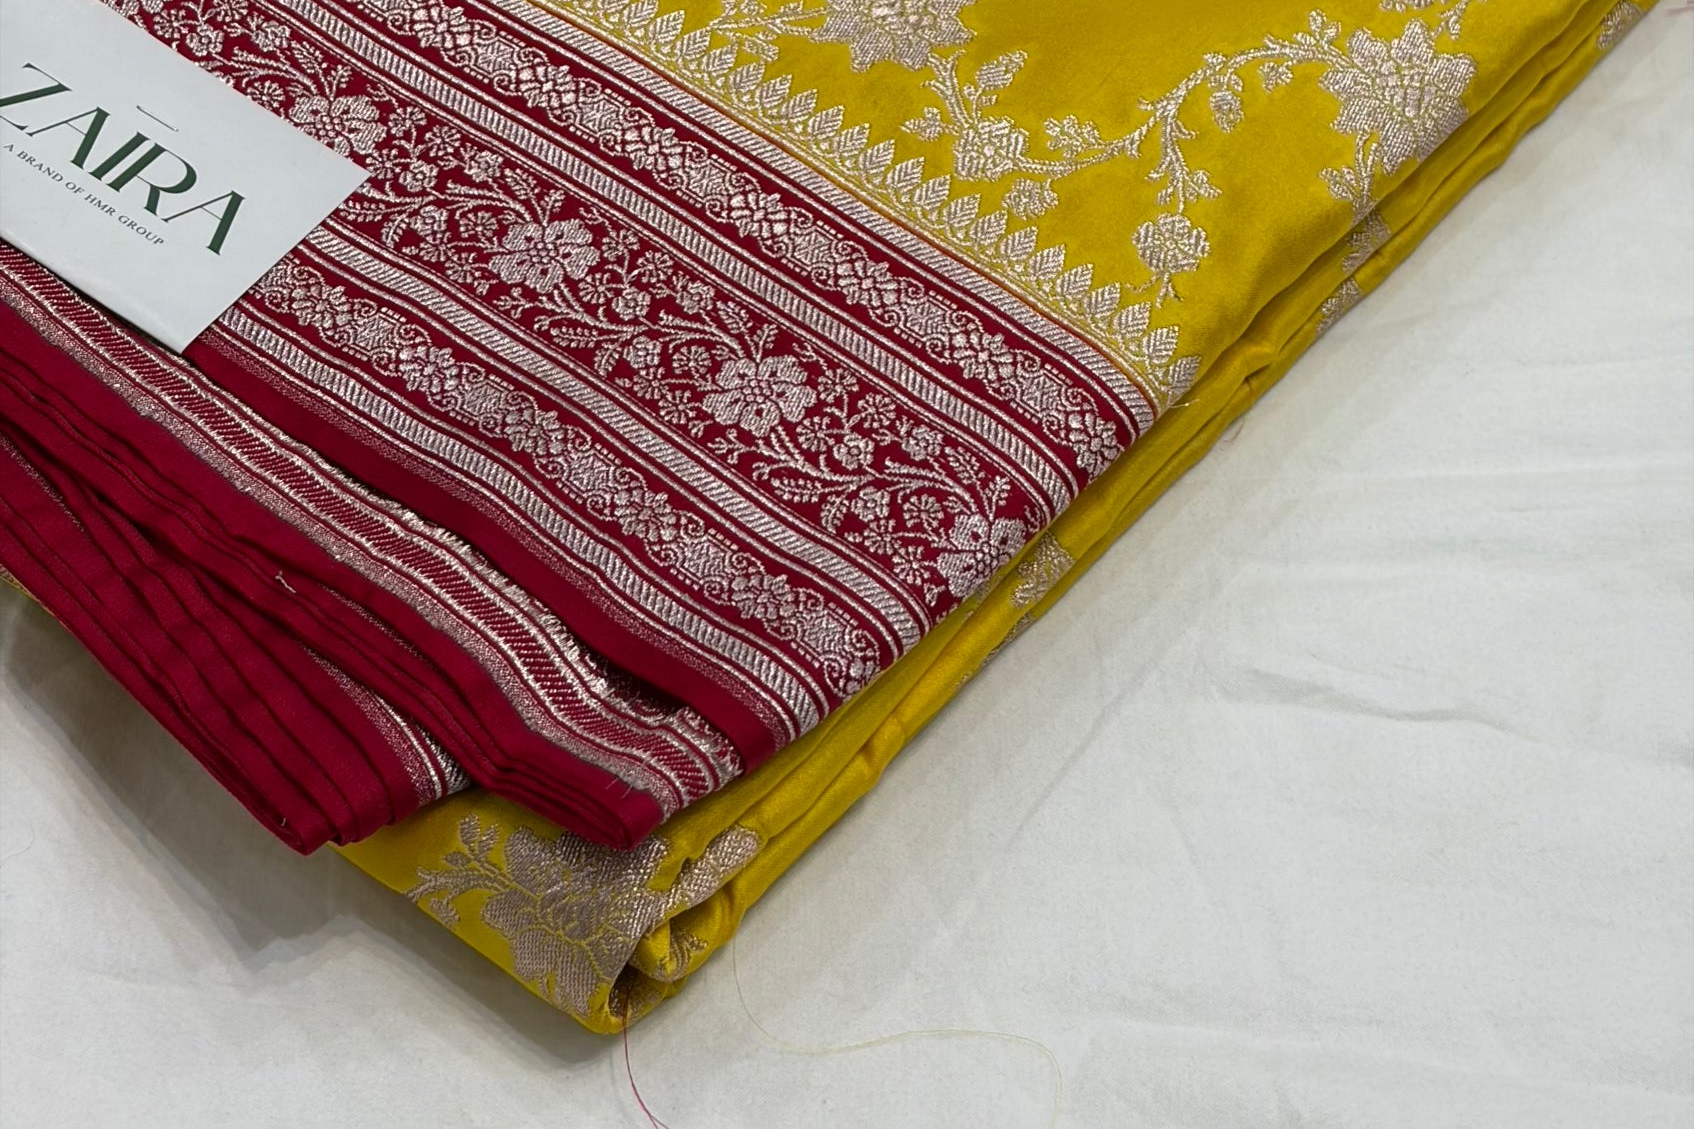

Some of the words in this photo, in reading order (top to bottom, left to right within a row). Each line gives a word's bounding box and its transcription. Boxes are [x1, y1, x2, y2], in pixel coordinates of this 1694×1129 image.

[3, 143, 15, 153] A
[16, 150, 64, 183] BRAND
[65, 181, 86, 195] OF
[84, 193, 117, 217] HMR
[118, 214, 165, 246] GROUP
